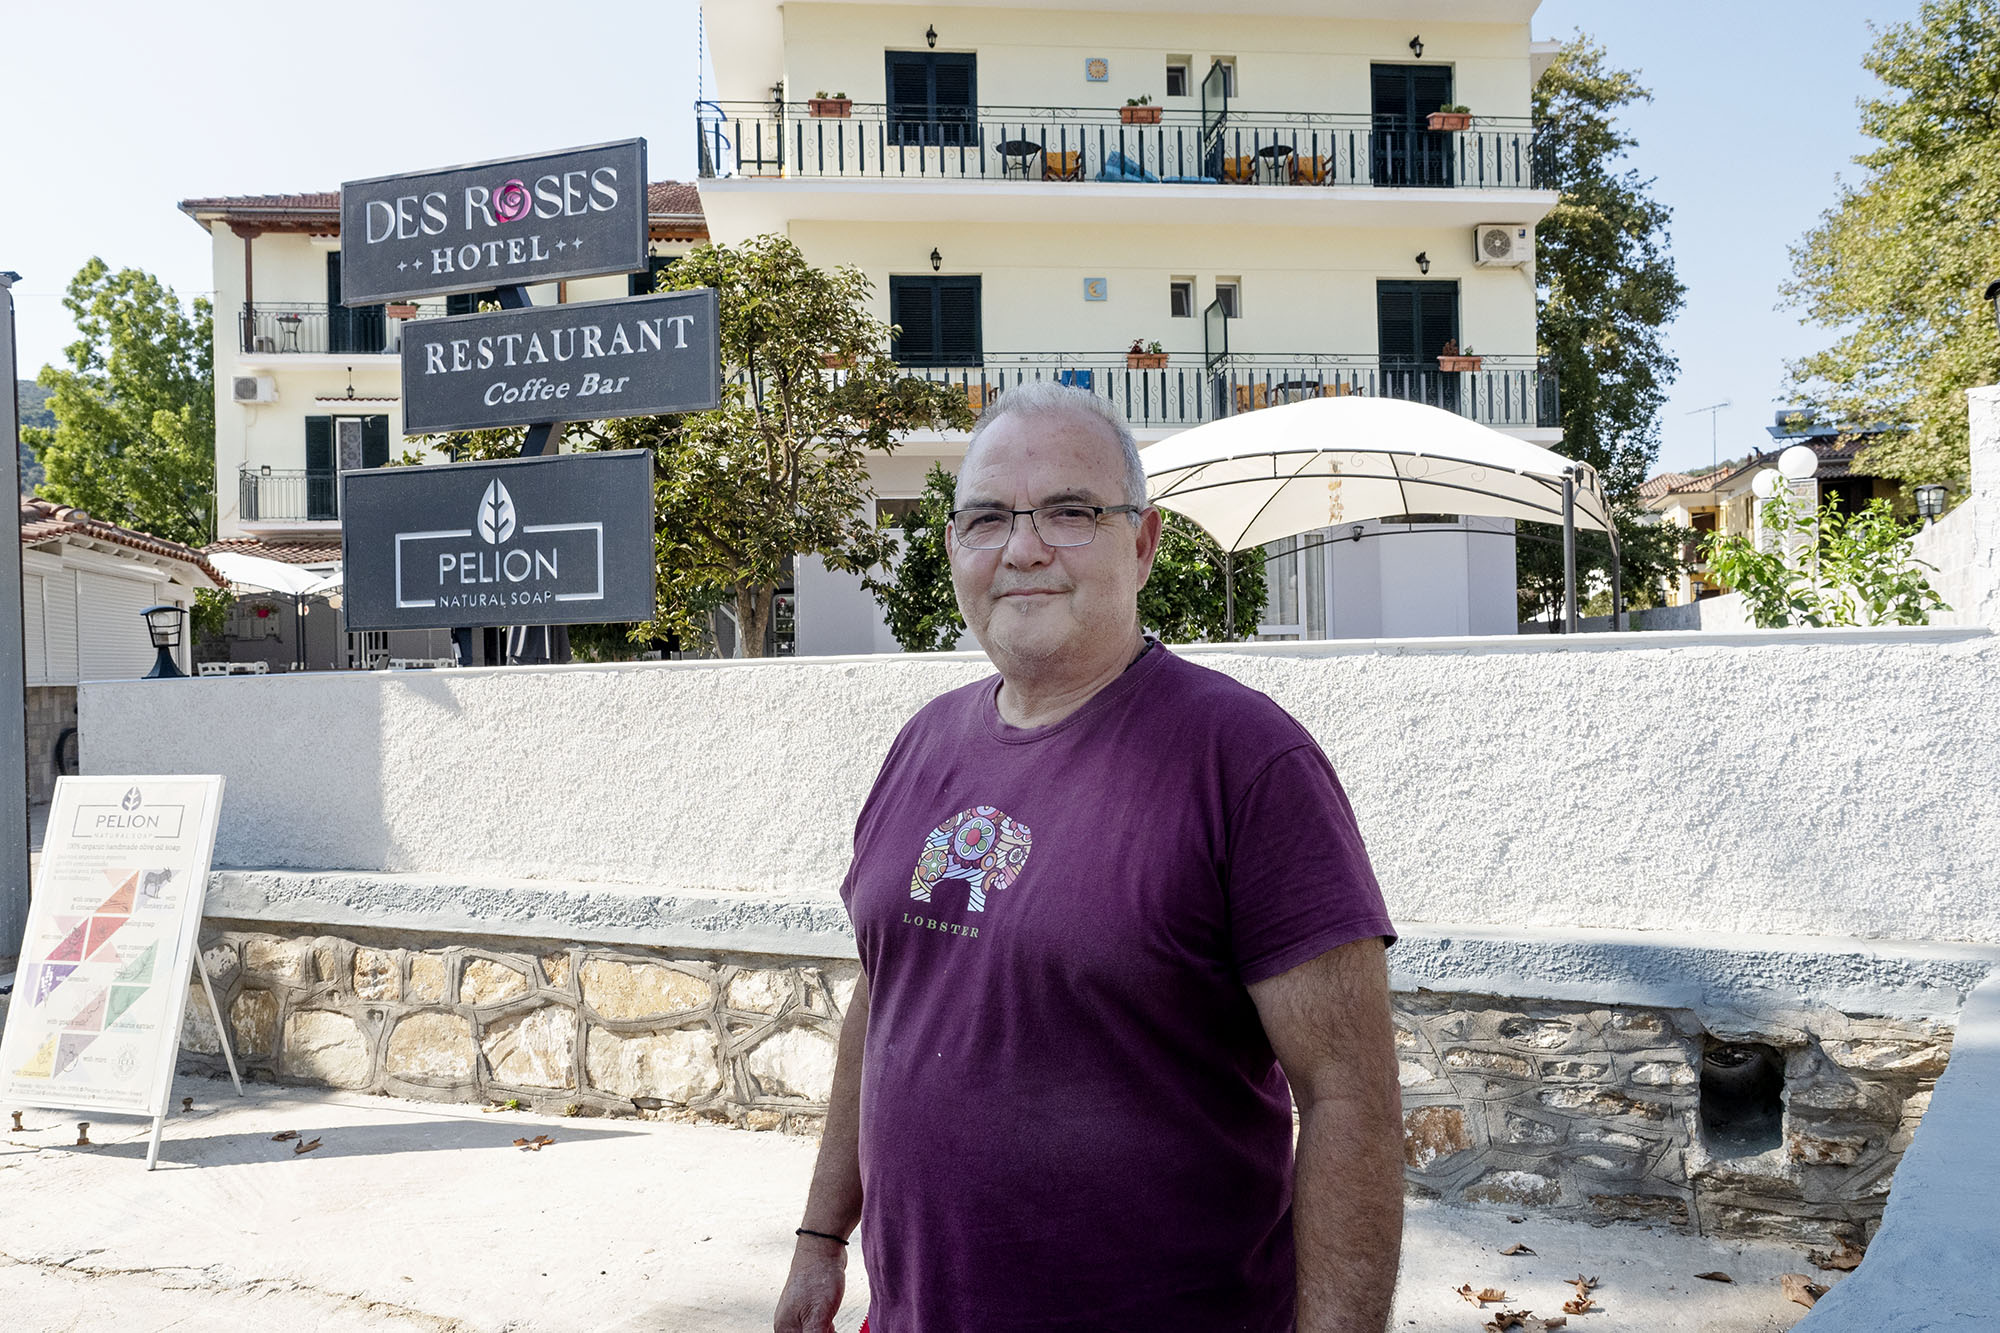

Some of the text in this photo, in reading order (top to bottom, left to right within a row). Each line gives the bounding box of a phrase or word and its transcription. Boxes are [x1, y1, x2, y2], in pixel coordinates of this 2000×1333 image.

[366, 191, 448, 245] DES
[431, 235, 550, 275] HOTEL
[424, 314, 695, 376] RESTAURANT
[483, 372, 630, 407] Coffee Bar
[439, 547, 558, 586] PELION
[440, 590, 552, 608] NATURAL SOAP
[95, 814, 160, 828] PELION
[106, 842, 139, 851] handmade
[165, 844, 181, 853] soap
[903, 913, 980, 938] LOBSTER
